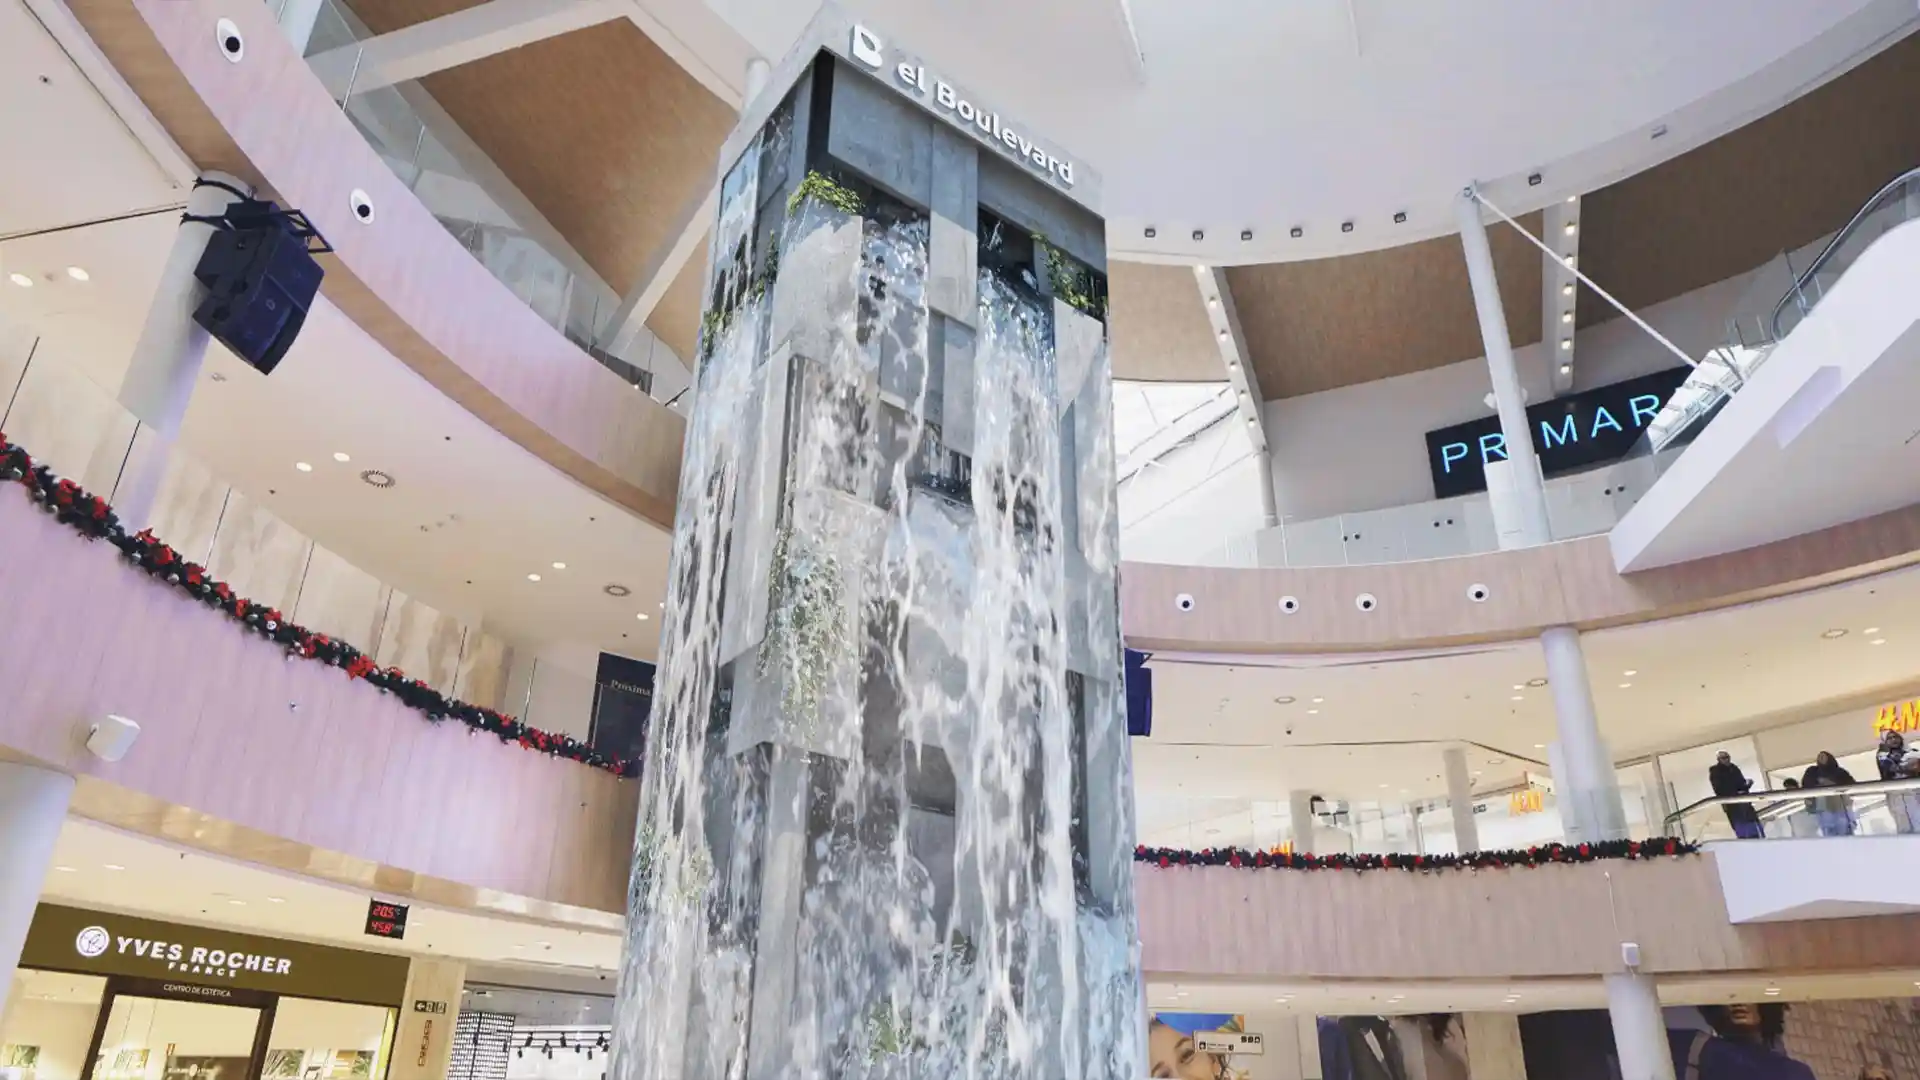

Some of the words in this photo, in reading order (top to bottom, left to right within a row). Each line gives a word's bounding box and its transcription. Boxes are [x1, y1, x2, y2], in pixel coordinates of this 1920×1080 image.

[897, 62, 925, 92] el
[936, 80, 1074, 185] Boulevard
[1441, 394, 1661, 473] PRMAR
[117, 935, 183, 961] YVES
[190, 946, 292, 975] ROCHER
[168, 961, 237, 978] FRANCE
[163, 983, 191, 993] CENTRO
[191, 986, 200, 995] DE
